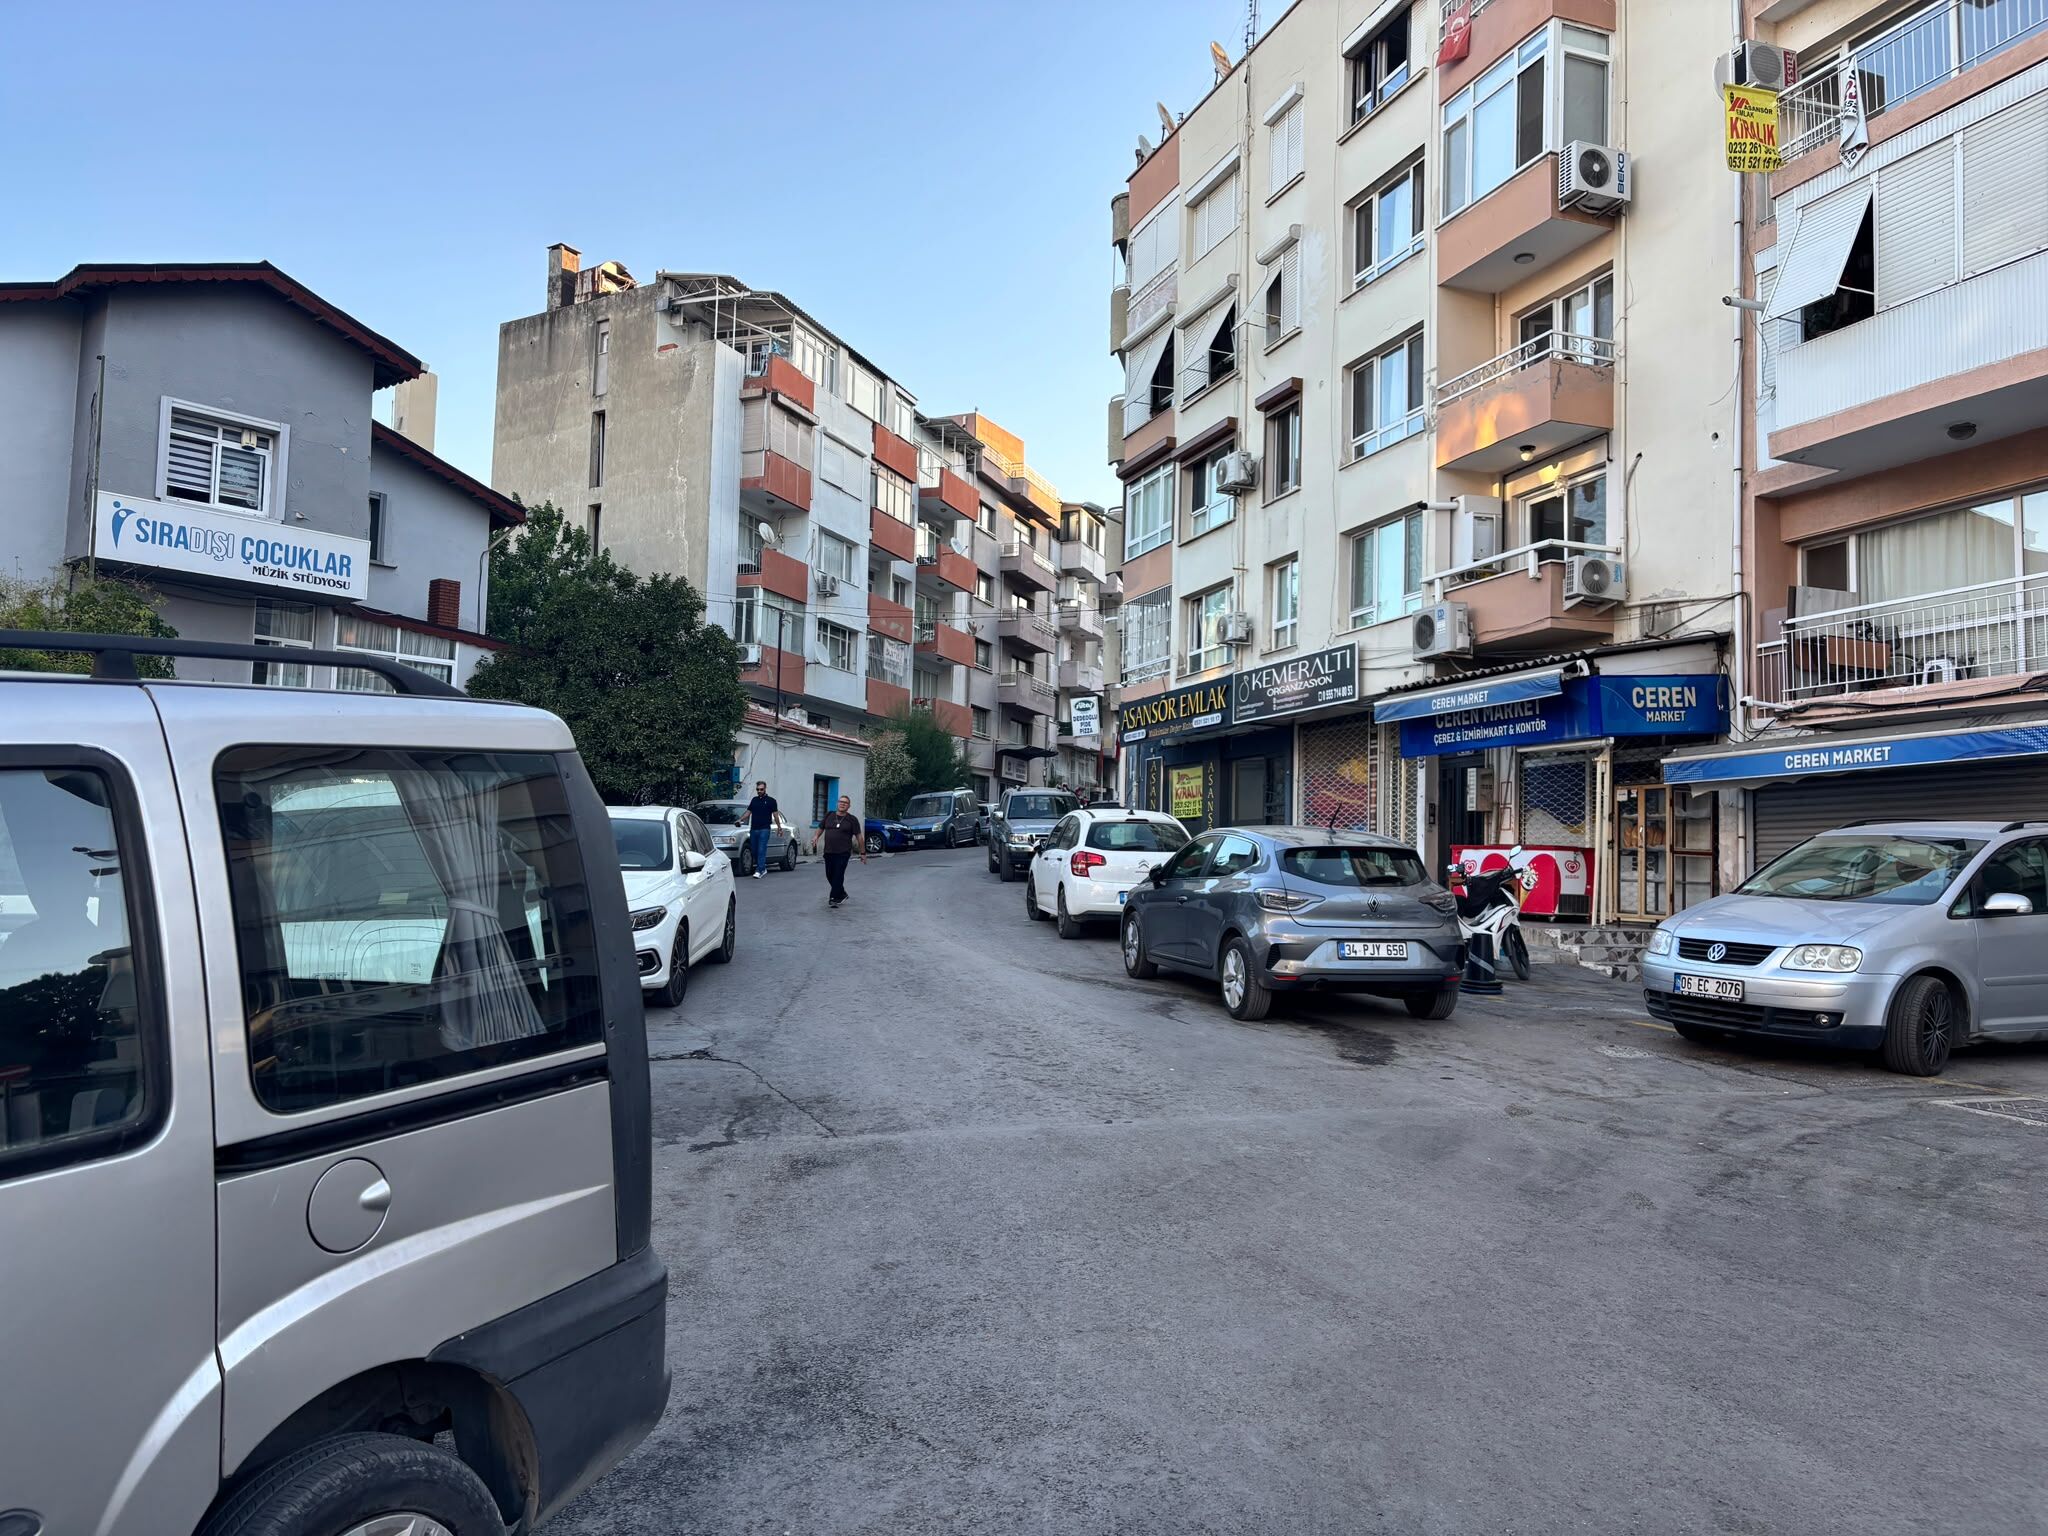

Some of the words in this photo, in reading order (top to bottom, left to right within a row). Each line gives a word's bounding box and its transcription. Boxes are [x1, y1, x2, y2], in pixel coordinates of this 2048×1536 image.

[1736, 109, 1754, 118] EMLAK
[1744, 105, 1773, 115] ASANSÖR
[1729, 142, 1747, 154] 0232
[1749, 142, 1761, 154] 261
[1729, 156, 1745, 169] 0531
[1748, 156, 1761, 169] 521
[1763, 157, 1771, 169] 15
[135, 517, 235, 562] SIRADIŞI
[241, 537, 352, 578] ÇOCUKLAR
[252, 565, 289, 580] MÜZİK
[292, 571, 351, 591] STÜDYOSU
[1252, 649, 1350, 691] KEMERALTI
[1121, 695, 1177, 731] ASANSÖR
[1180, 684, 1227, 717] EMLAK
[1431, 695, 1456, 710] CEREN
[1457, 690, 1488, 706] MARKET
[1632, 687, 1696, 709] CEREN
[1436, 708, 1479, 728] CEREN
[1483, 699, 1541, 723] MARKET
[1646, 710, 1686, 722] MARKET
[1434, 732, 1454, 746] ÇEREZ
[1456, 732, 1461, 741] &
[1509, 724, 1514, 735] &
[1516, 717, 1546, 734] KONTÖR
[1785, 752, 1829, 769] CEREN
[1833, 746, 1891, 765] MARKET
[1346, 944, 1357, 955] 34
[1363, 944, 1380, 955] PJY
[1386, 944, 1404, 956] 658
[1681, 976, 1692, 990] 06
[1697, 978, 1709, 992] EC
[1715, 981, 1740, 996] 2076
